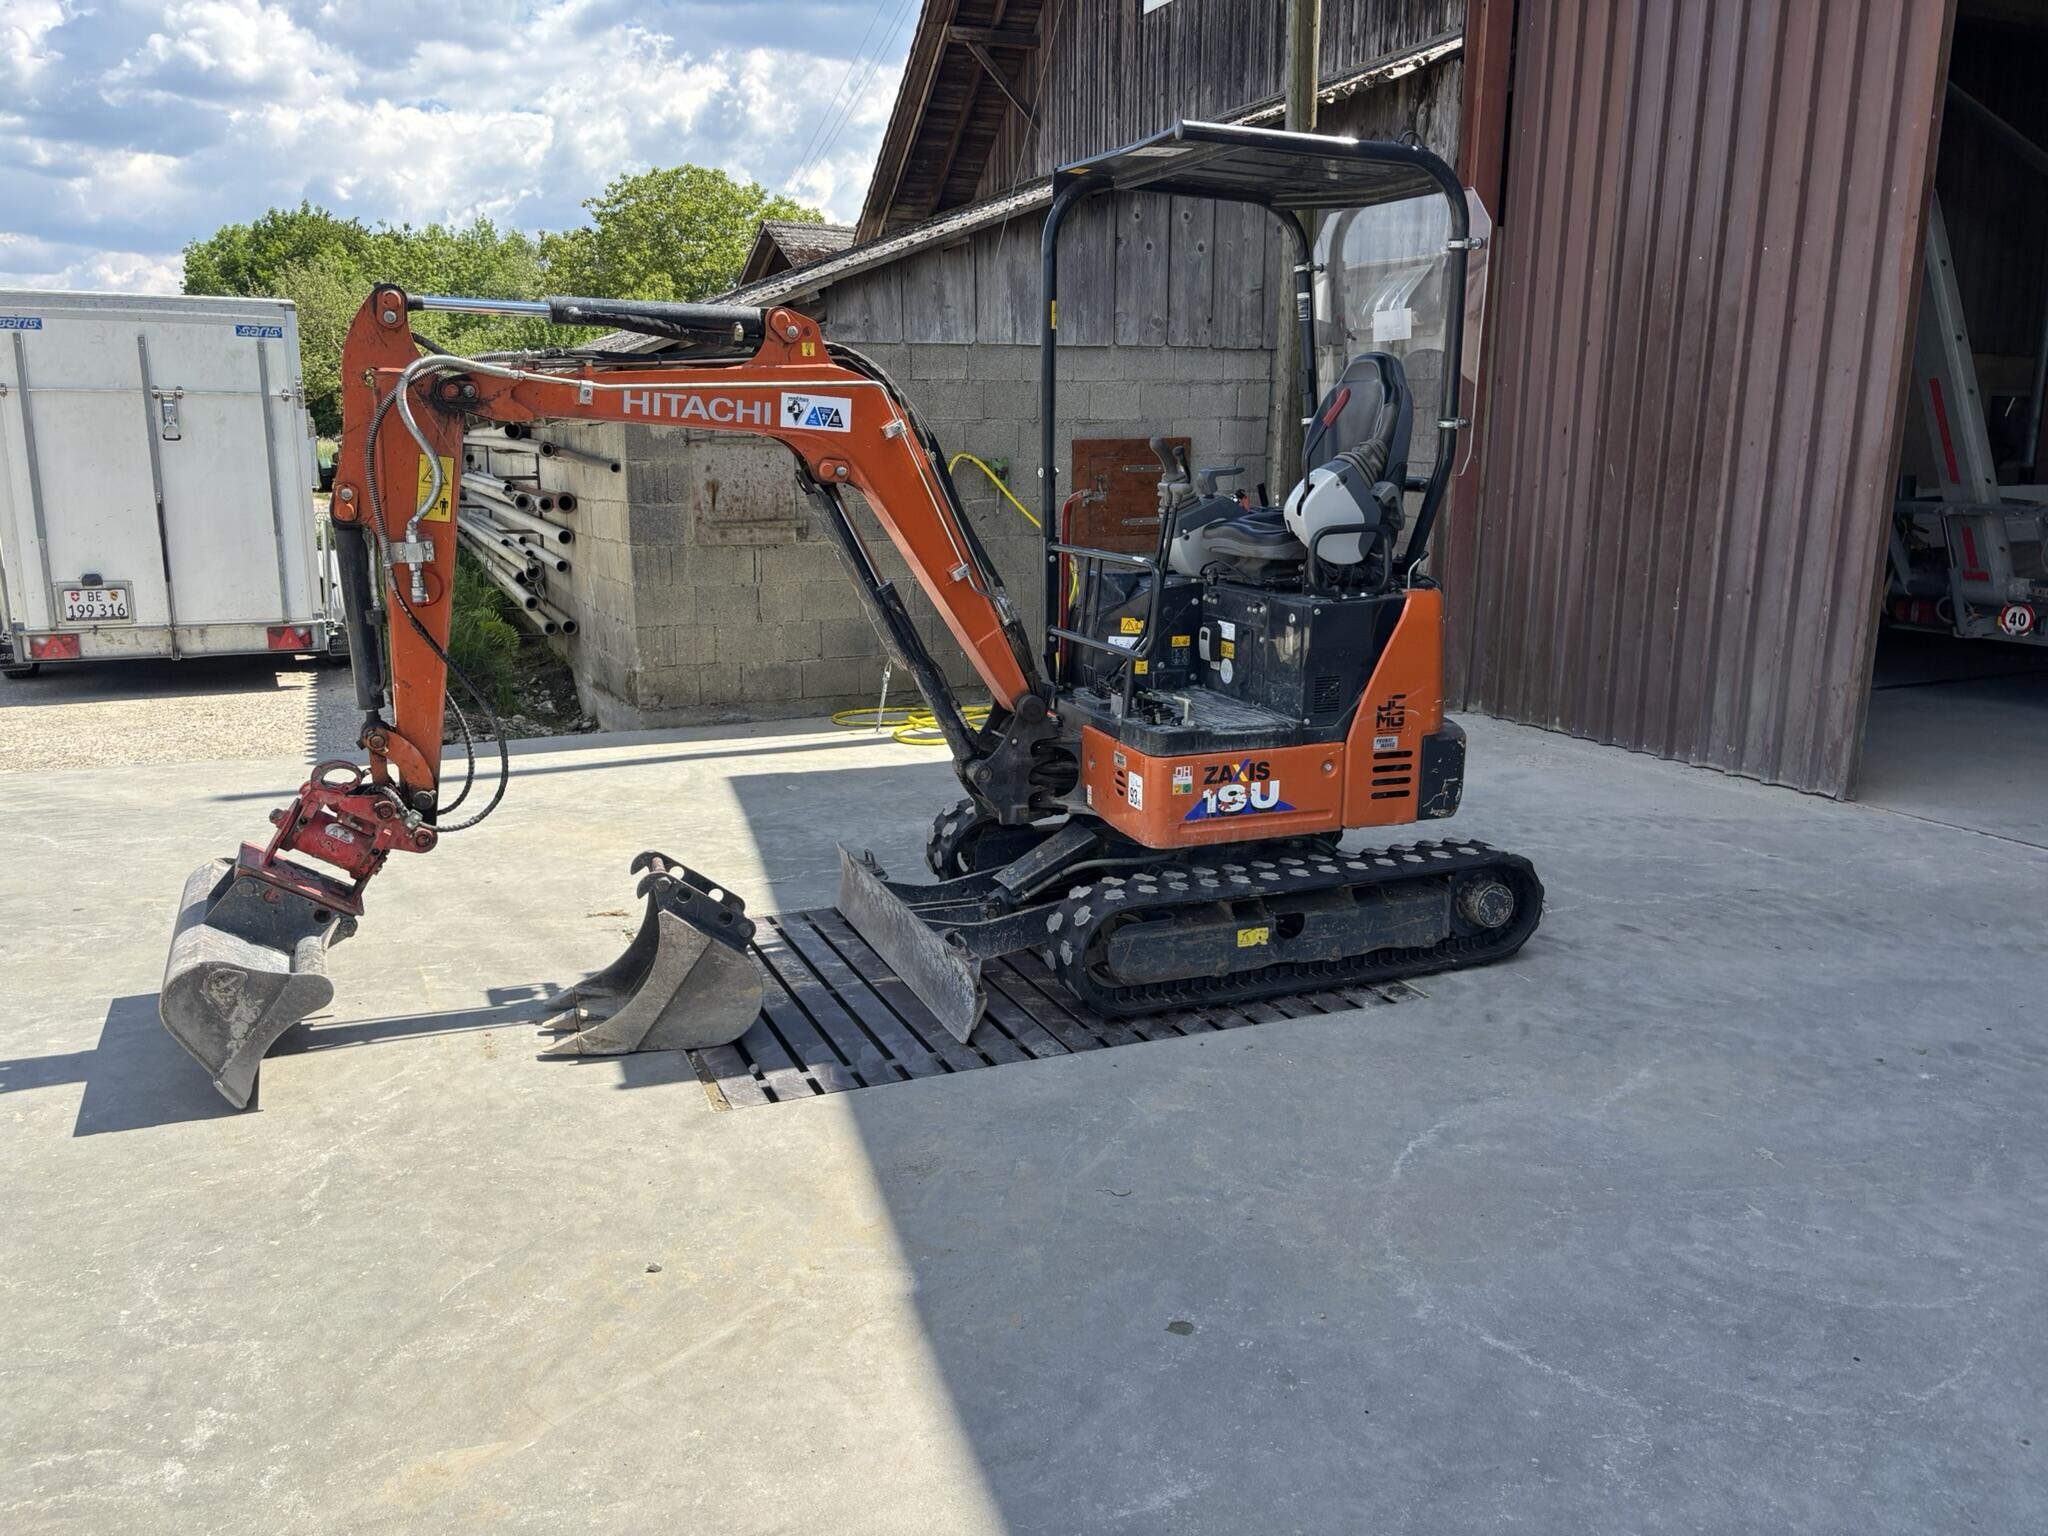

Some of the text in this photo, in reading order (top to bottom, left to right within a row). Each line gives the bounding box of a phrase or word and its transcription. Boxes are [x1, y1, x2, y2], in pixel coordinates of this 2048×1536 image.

[239, 326, 281, 337] saris
[623, 390, 771, 425] HITACHI
[87, 591, 103, 602] BE
[68, 603, 126, 618] 199 316
[2008, 612, 2027, 627] 40
[1204, 758, 1270, 784] ZAXIS
[1130, 787, 1138, 805] 93
